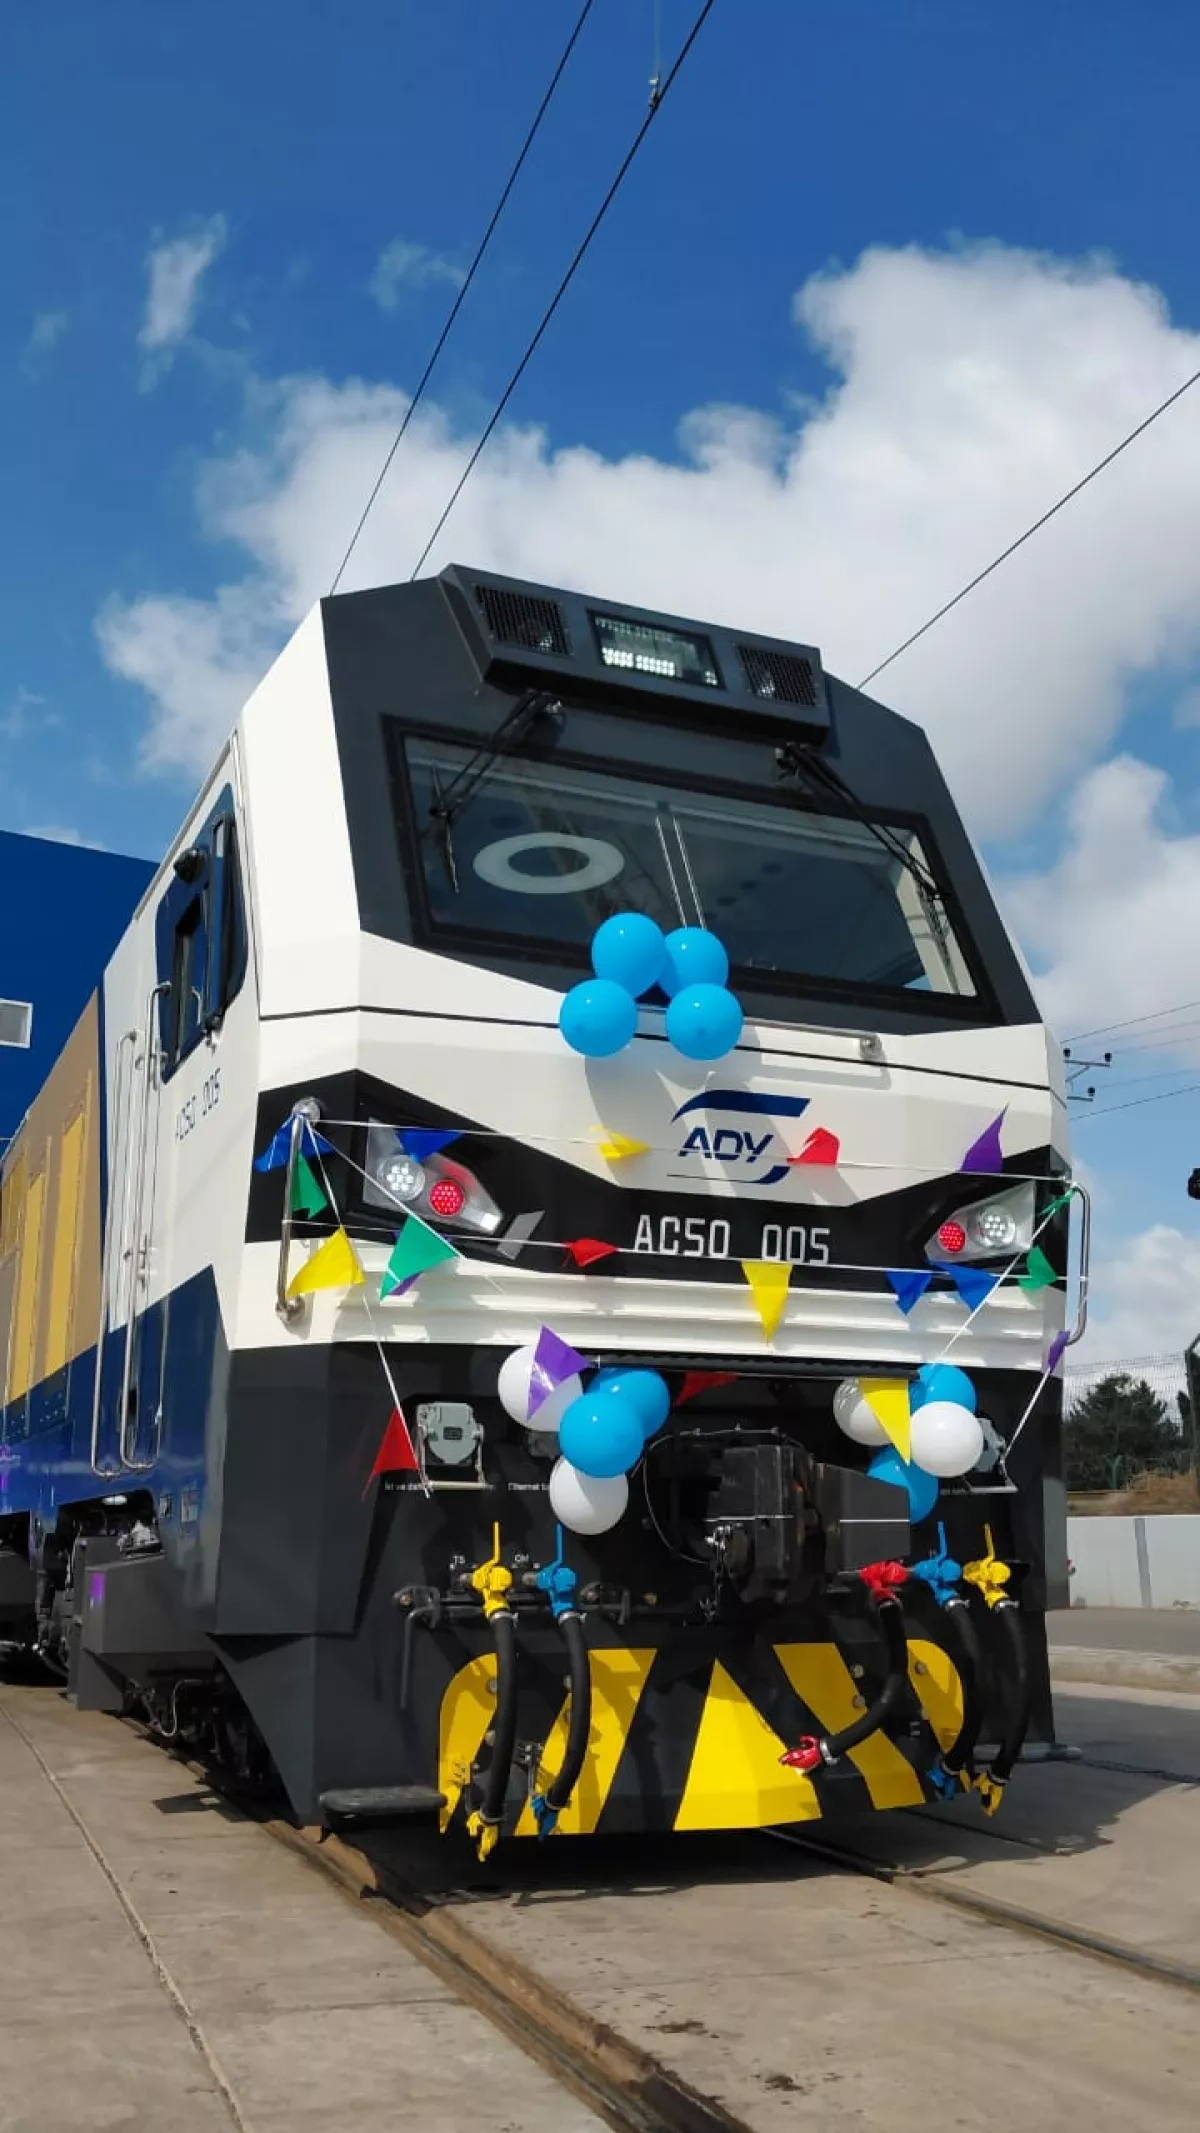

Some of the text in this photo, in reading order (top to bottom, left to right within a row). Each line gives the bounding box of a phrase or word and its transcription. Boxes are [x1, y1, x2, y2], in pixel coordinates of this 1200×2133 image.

[202, 1068, 221, 1116] 005
[678, 1126, 774, 1163] ADY
[633, 1213, 831, 1266] AC50 005
